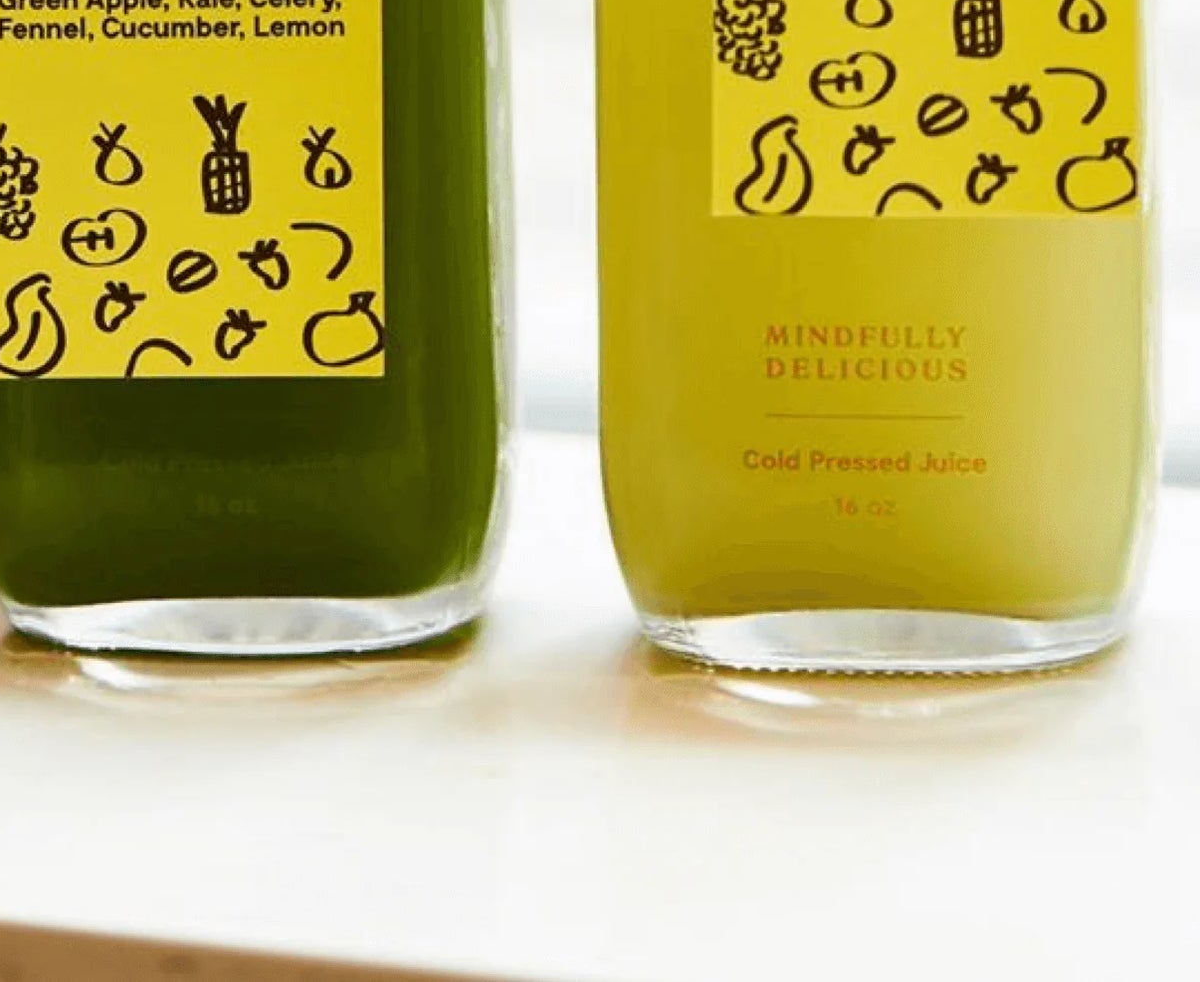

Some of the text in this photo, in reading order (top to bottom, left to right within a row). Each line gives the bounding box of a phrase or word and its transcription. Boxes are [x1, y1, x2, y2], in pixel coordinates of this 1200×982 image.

[101, 16, 246, 41] Cucumber,
[253, 16, 345, 38] Lemon
[763, 324, 967, 349] MINDFULLY
[765, 357, 967, 382] DELICIOUS
[743, 449, 987, 474] Cold Pressed Juice
[835, 497, 897, 516] 16 oz
